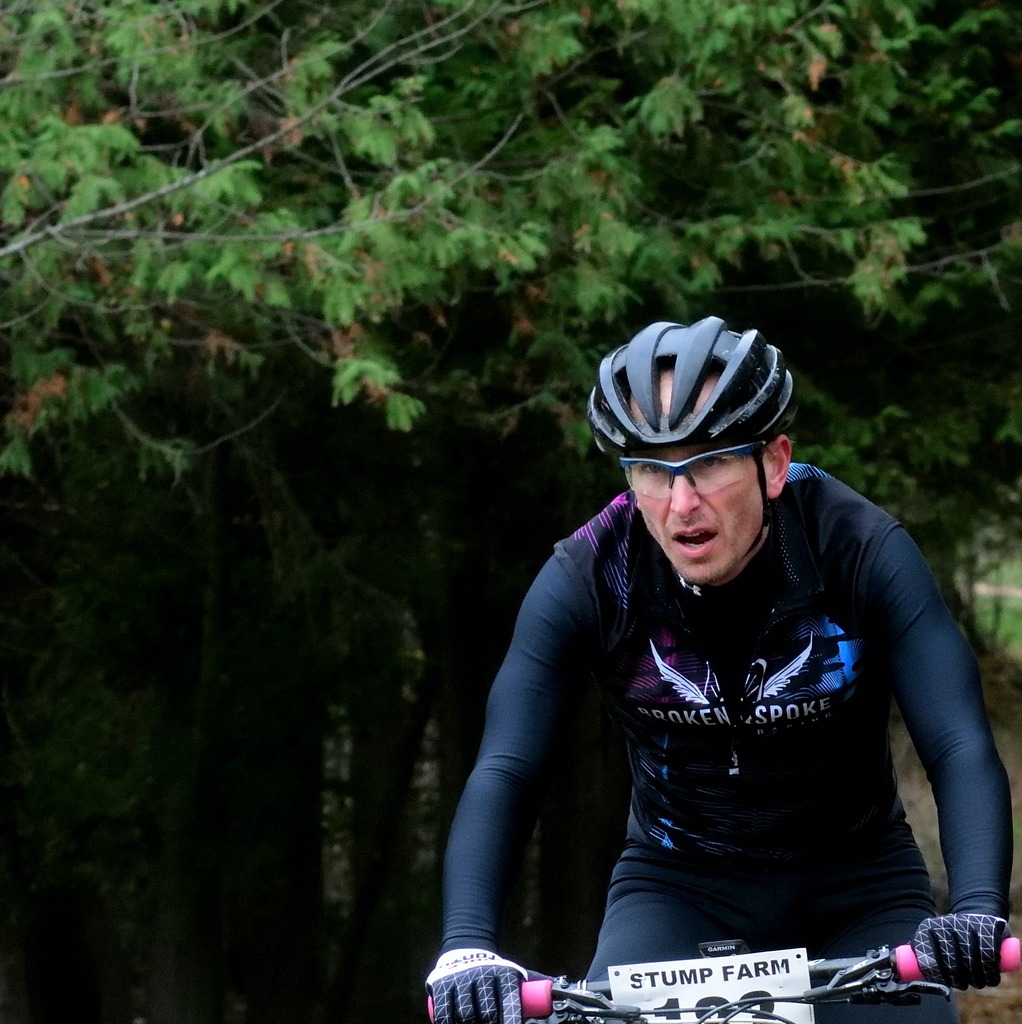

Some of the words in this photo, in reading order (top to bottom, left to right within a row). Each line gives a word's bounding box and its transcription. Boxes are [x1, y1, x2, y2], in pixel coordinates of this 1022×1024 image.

[755, 698, 832, 724] SPOKE
[707, 944, 736, 952] GARMIN
[630, 967, 714, 989] STUMP
[722, 958, 791, 982] FARM
